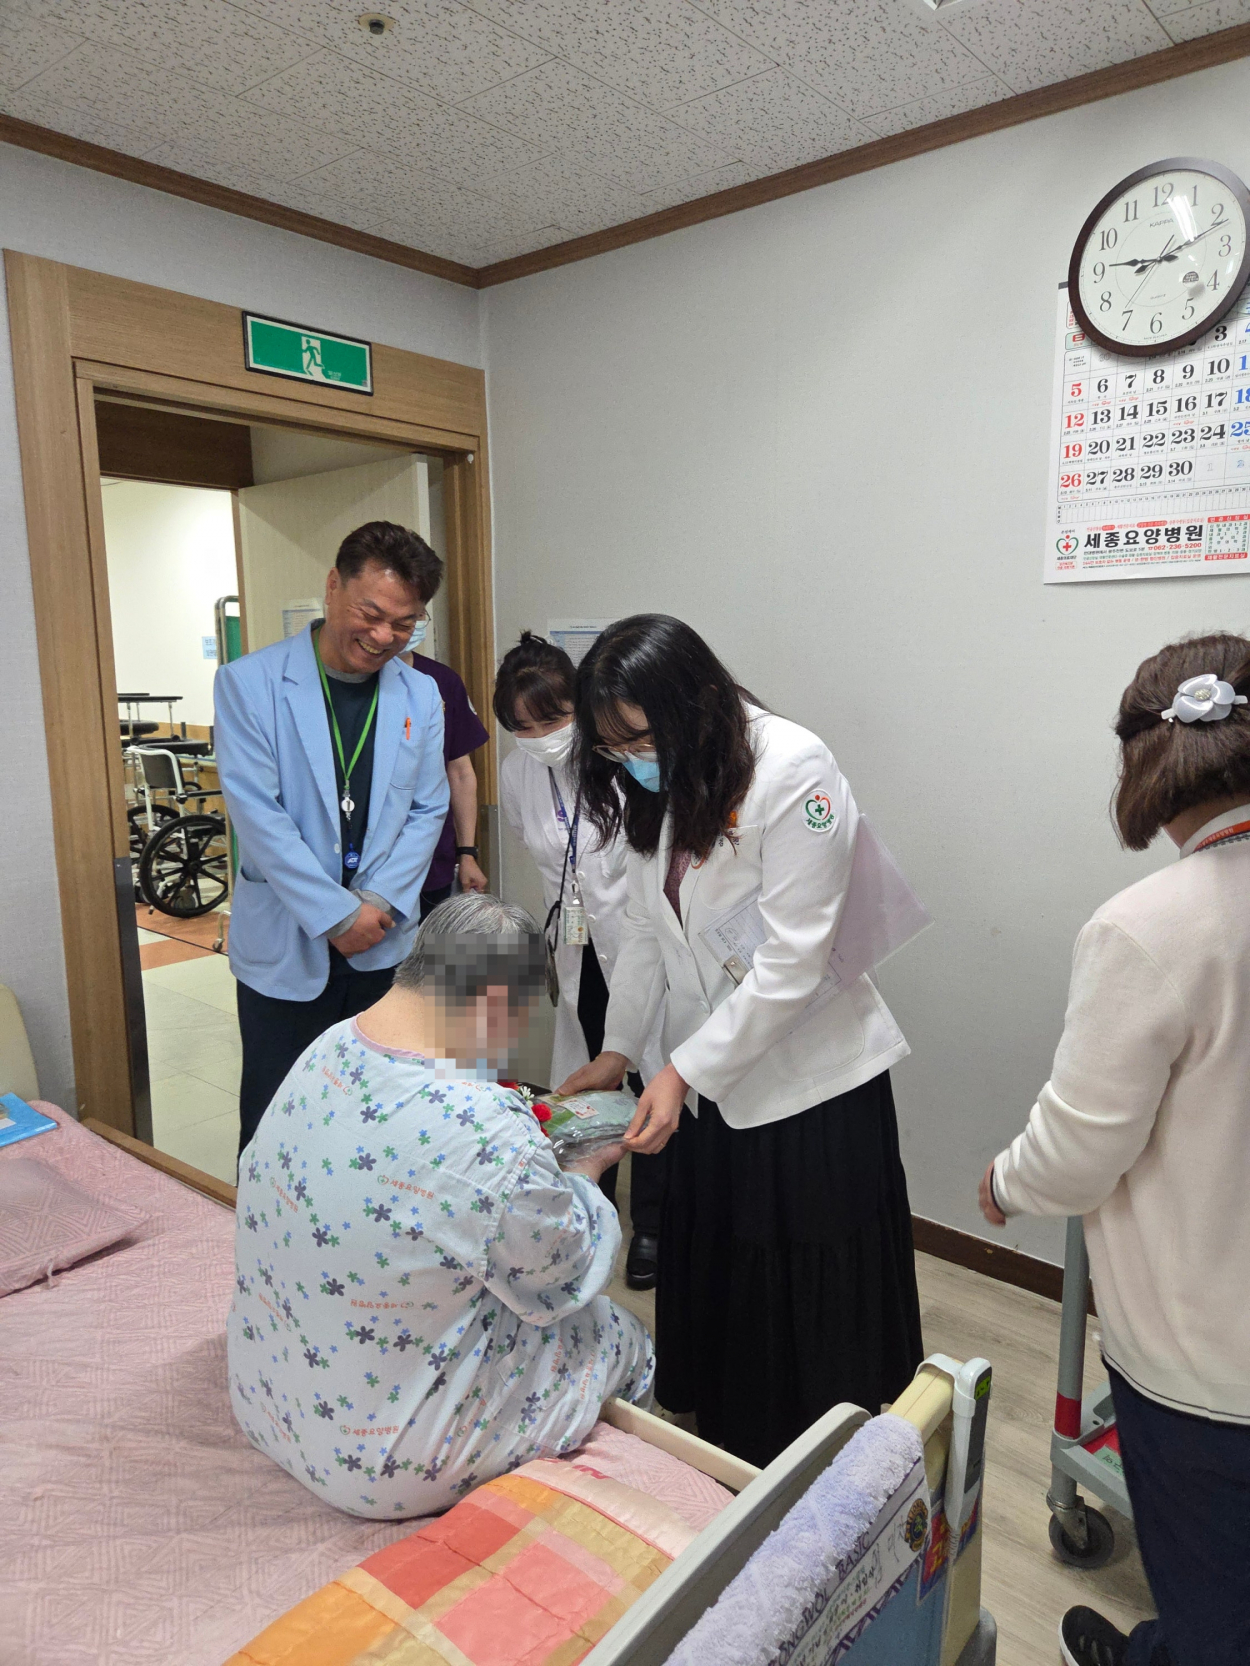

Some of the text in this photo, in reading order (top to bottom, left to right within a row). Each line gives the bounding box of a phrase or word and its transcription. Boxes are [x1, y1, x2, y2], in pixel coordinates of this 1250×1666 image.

[1152, 182, 1174, 208] 12
[1192, 185, 1198, 206] 1
[1123, 200, 1139, 223] 11
[1210, 203, 1225, 227] 2
[1099, 228, 1118, 251] 10
[1218, 234, 1232, 257] 3
[1093, 262, 1106, 284] 9
[1206, 270, 1220, 291] 4
[1100, 291, 1112, 312] 8
[1182, 297, 1194, 320] 5
[1122, 310, 1133, 331] 7
[1150, 312, 1162, 334] 6
[1214, 326, 1227, 341] 3
[1182, 364, 1194, 379] 9
[1207, 358, 1230, 376] 10
[1125, 374, 1136, 388] 7
[1152, 369, 1165, 384] 8
[1071, 382, 1082, 397] 5
[1097, 378, 1108, 393] 6
[1175, 396, 1197, 413] 16
[1205, 391, 1228, 408] 17
[1091, 409, 1111, 425] 13
[1118, 405, 1138, 421] 14
[1146, 400, 1168, 417] 15
[1065, 413, 1084, 429] 12
[1142, 432, 1166, 448] 22
[1171, 428, 1195, 444] 23
[1200, 424, 1226, 441] 24
[1064, 443, 1082, 459] 19
[1088, 440, 1110, 455] 20
[1115, 436, 1136, 452] 21
[1112, 467, 1135, 482] 28
[1140, 464, 1163, 480] 29
[1168, 460, 1193, 477] 30
[1060, 473, 1082, 488] 26
[1086, 470, 1108, 485] 27
[1084, 525, 1203, 548] 세종요양병원
[390, 1180, 434, 1200] 세종요양병원
[353, 1425, 399, 1437] 세종요양병원
[835, 1530, 870, 1582] BASIC
